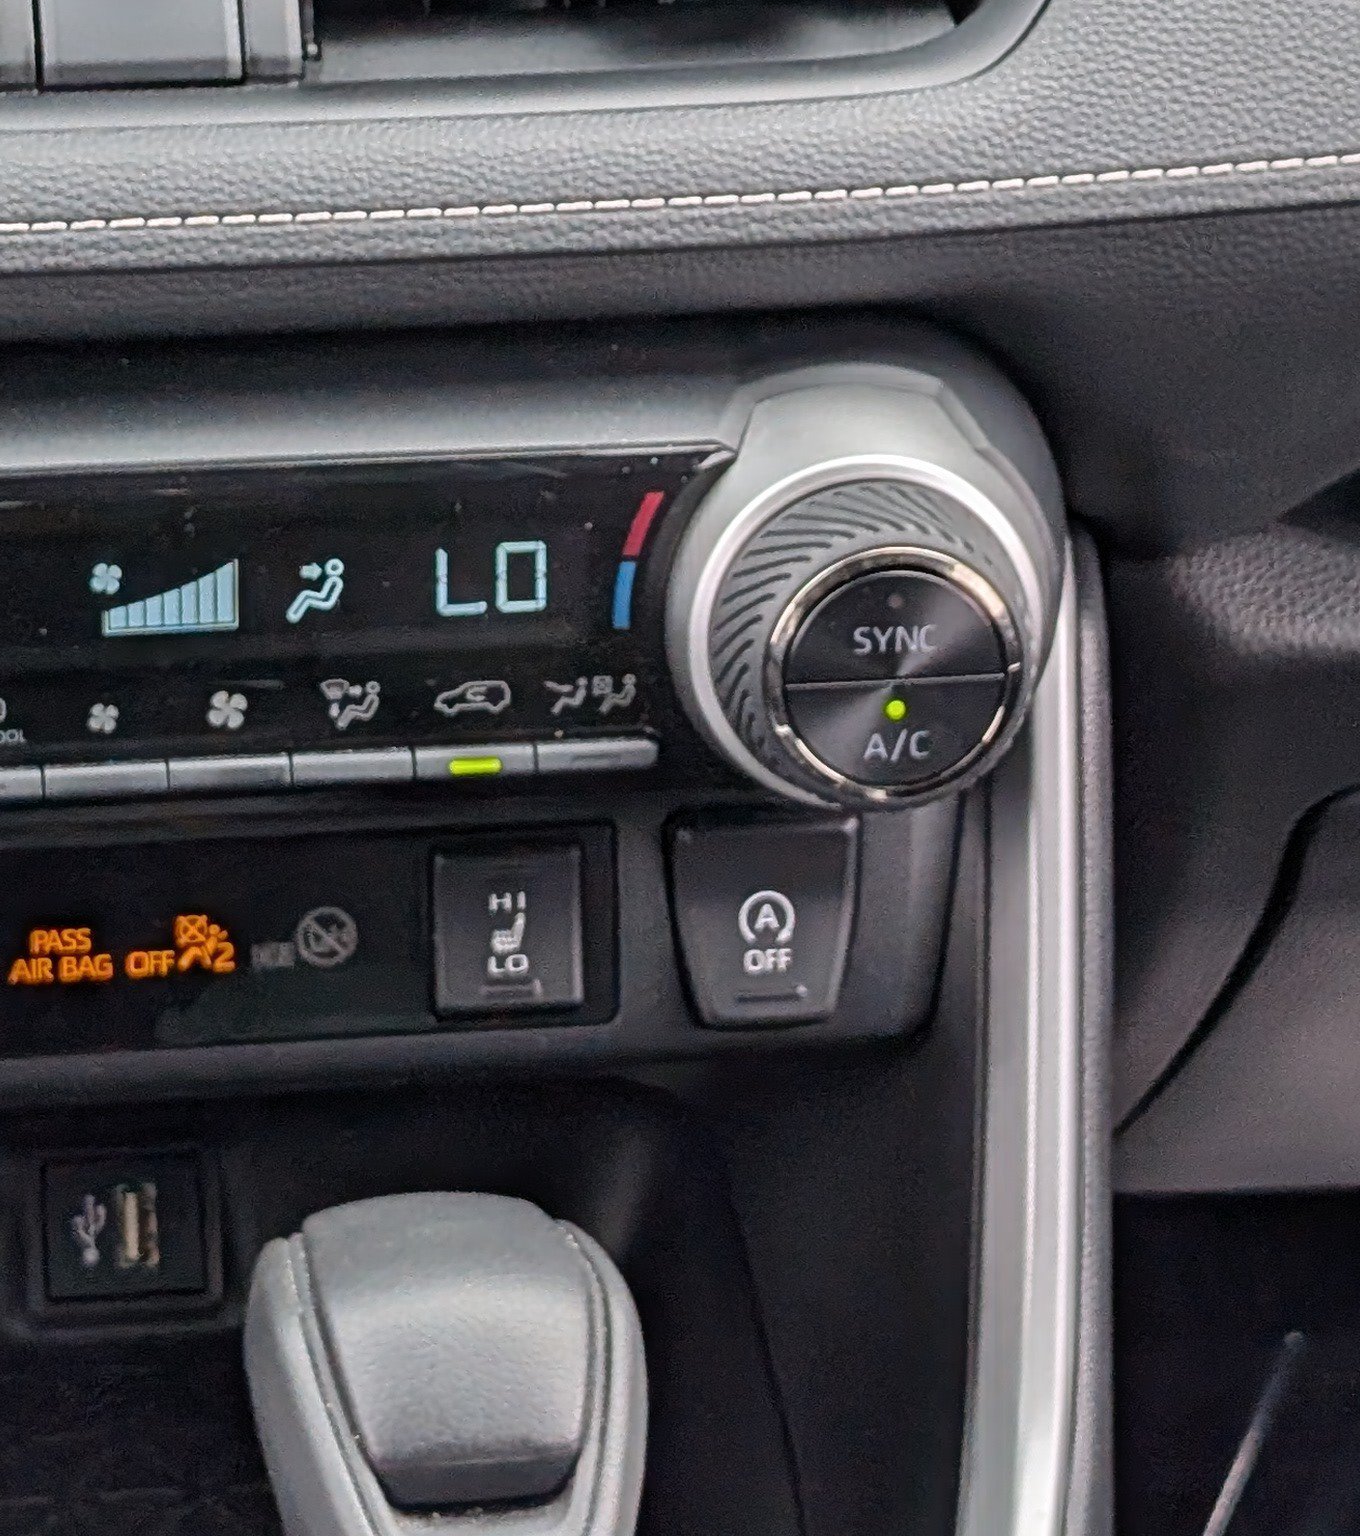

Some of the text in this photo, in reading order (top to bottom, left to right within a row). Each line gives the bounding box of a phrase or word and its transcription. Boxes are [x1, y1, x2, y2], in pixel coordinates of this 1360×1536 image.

[435, 541, 547, 616] LO
[852, 624, 938, 655] SYNC
[863, 729, 931, 761] A/C
[487, 891, 527, 912] HI
[30, 928, 92, 954] PASS
[8, 949, 176, 985] AIR BAG OFF
[487, 953, 529, 977] LO
[742, 948, 792, 975] OFF
